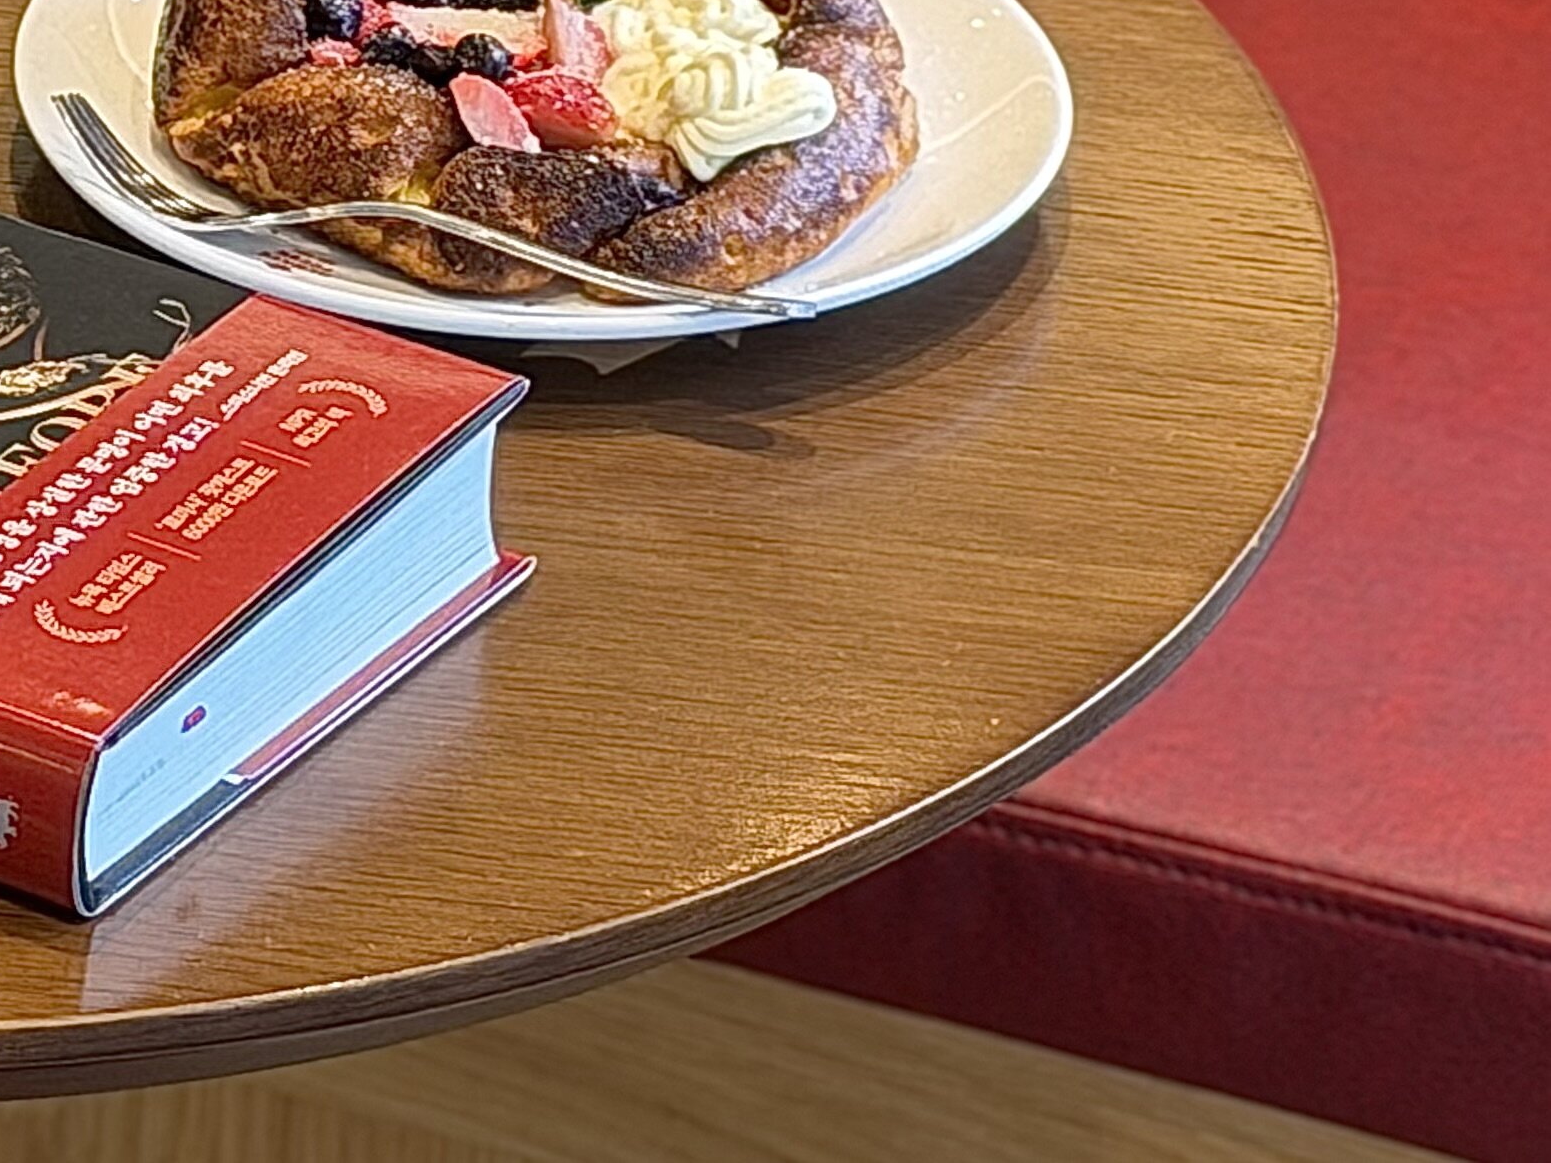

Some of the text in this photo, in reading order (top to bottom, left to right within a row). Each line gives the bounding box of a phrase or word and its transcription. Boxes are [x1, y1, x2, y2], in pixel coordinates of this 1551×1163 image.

[25, 473, 93, 519] 상실한
[76, 428, 146, 474] 문명이
[134, 399, 185, 431] 어떤
[168, 360, 235, 403] 최후를
[0, 526, 87, 592] 되는지에
[71, 495, 124, 529] 관한
[110, 451, 176, 496] 엄중한
[162, 416, 220, 454] 경고!
[221, 465, 279, 505] 다운로드
[68, 553, 144, 607] 뉴욕 타임스
[94, 561, 167, 614] 베스트셀러
